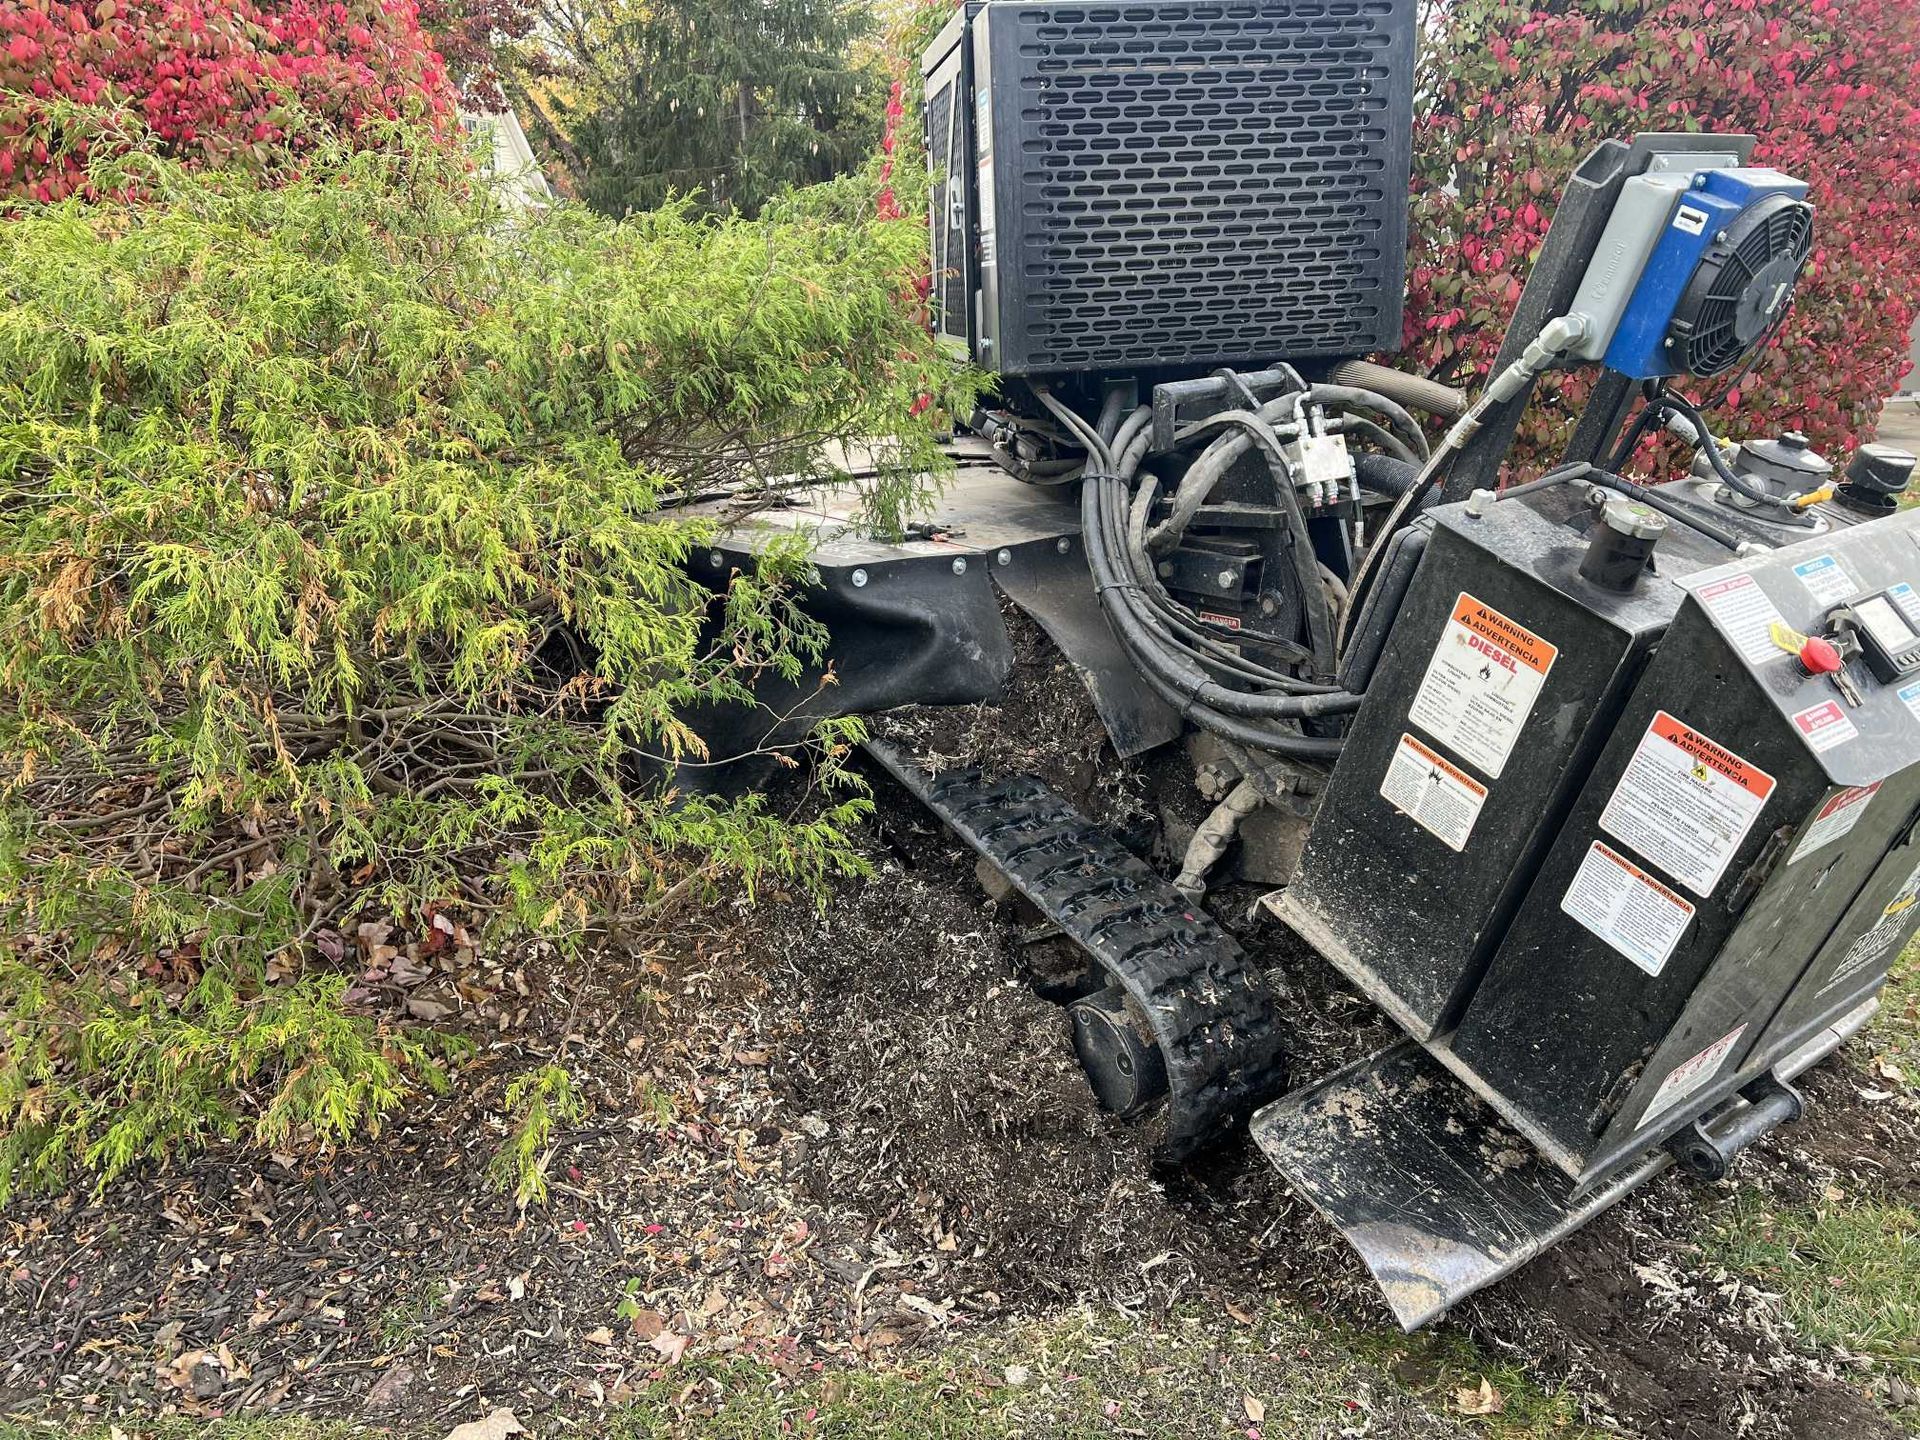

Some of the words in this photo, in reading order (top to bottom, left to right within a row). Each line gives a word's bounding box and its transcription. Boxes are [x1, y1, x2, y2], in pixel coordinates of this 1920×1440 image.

[1211, 616, 1237, 627] DANGER
[1488, 613, 1534, 647] WARNING
[1467, 633, 1520, 674] DIESEL
[1472, 619, 1539, 666] ADVERTENCIA
[1410, 741, 1437, 762] WARNING
[1444, 765, 1485, 795] ADVERTENCIA
[1678, 738, 1749, 786] ADVERTENCIA
[1693, 736, 1743, 770] WARNING
[1690, 777, 1712, 794] HAZARD
[1601, 848, 1631, 870] WARNING
[1645, 878, 1691, 911] ADVERTENCIA
